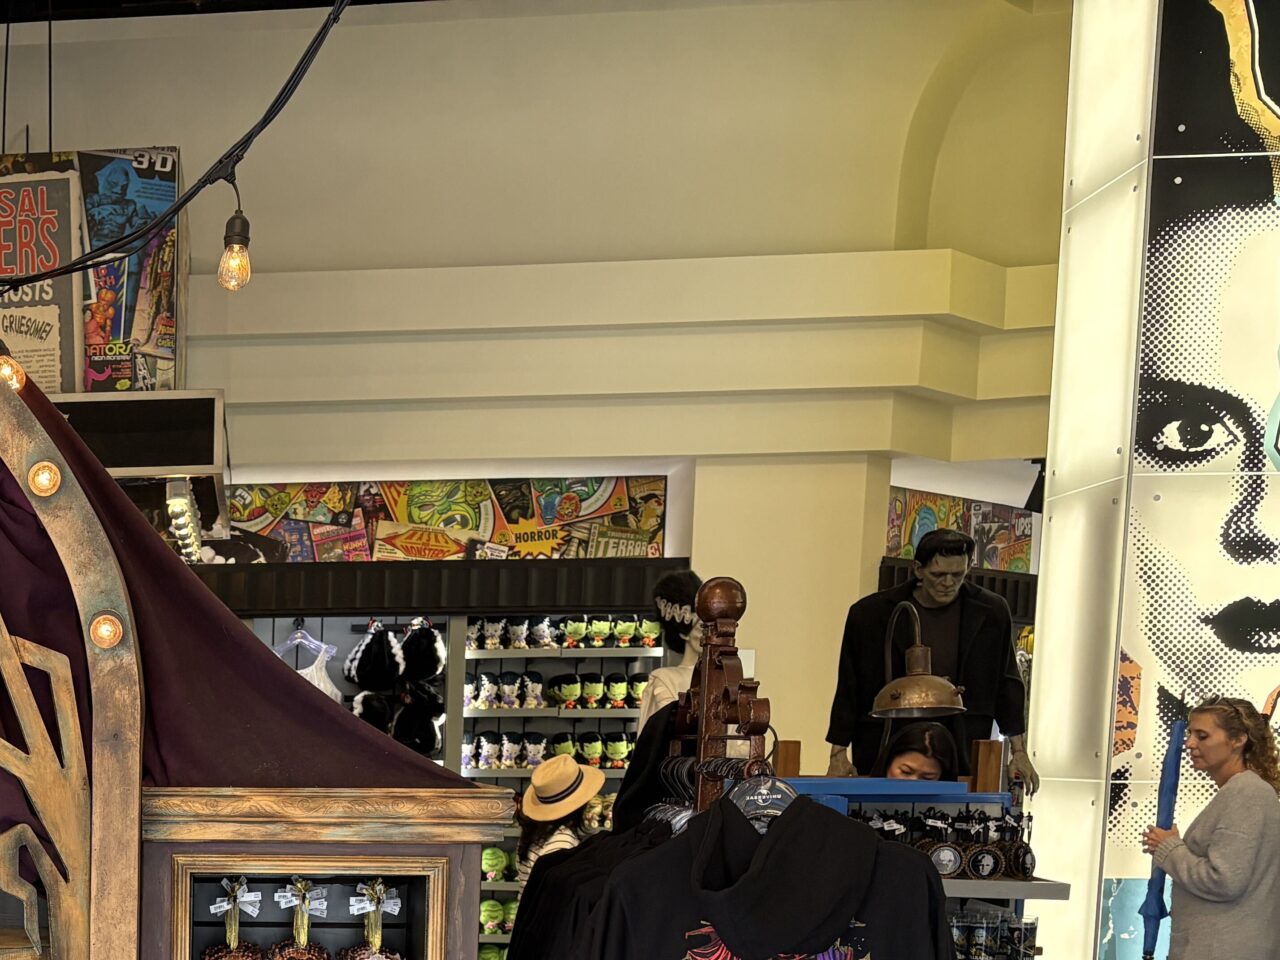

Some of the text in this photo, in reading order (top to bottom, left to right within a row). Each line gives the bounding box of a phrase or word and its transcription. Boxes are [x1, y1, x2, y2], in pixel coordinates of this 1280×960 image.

[1, 314, 54, 342] GRUESOME!
[514, 529, 559, 544] HORROR
[597, 537, 648, 558] TERROR
